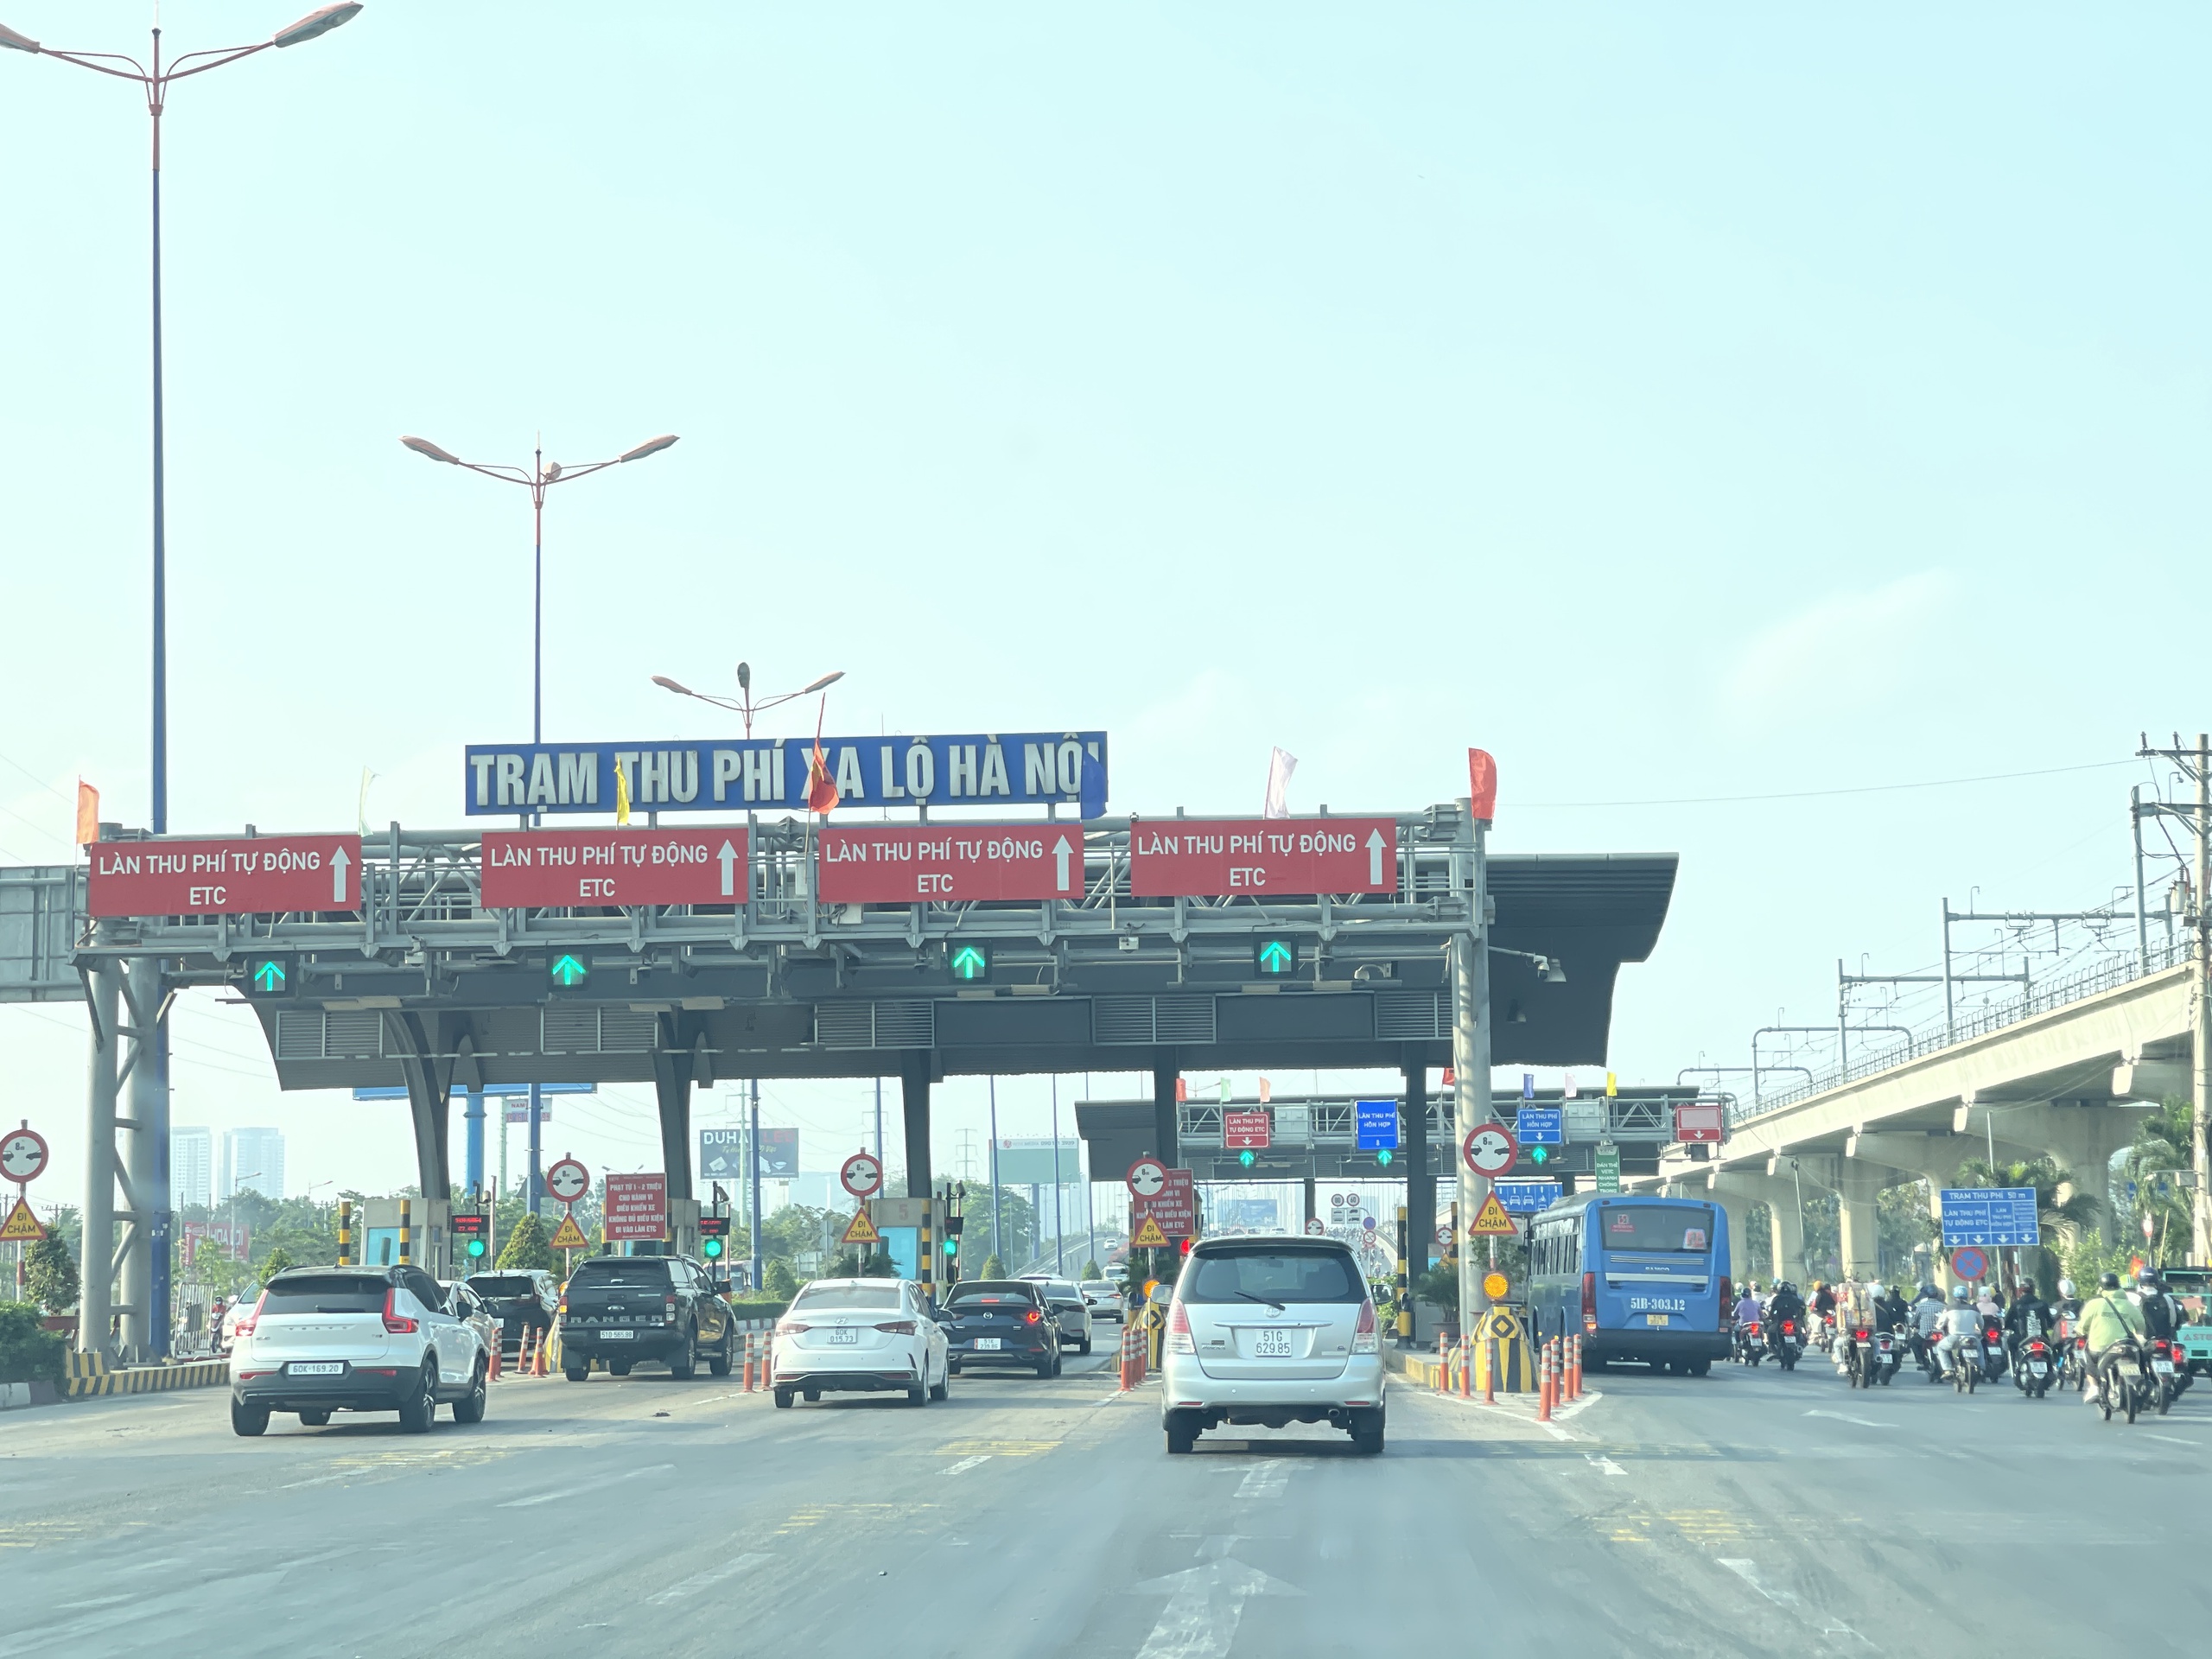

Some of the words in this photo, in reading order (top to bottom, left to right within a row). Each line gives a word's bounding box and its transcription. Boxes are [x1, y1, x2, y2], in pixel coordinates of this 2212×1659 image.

[470, 752, 598, 813] TRẠM
[615, 749, 699, 804] THU
[713, 738, 785, 802] PHÍ
[880, 735, 935, 805] LỘ
[948, 734, 1011, 797] HÀ
[1024, 732, 1099, 802] NỘ
[826, 839, 867, 862] LÀN
[872, 842, 912, 861] THU
[918, 837, 952, 861] PHÍ
[956, 839, 982, 863] TỰ
[987, 836, 1043, 862] ĐỘNG
[1137, 832, 1179, 855] LÀN
[1184, 835, 1224, 854] THU
[1230, 830, 1264, 854] PHÍ
[1268, 832, 1295, 856] TỰ
[1300, 830, 1356, 856] ĐỘNG
[491, 844, 531, 867] LÀN
[537, 847, 576, 866] THU
[582, 842, 616, 865] PHÍ
[620, 844, 647, 868] TỰ
[652, 841, 708, 867] ĐỘNG
[99, 851, 140, 875] LÀN
[146, 855, 187, 874] THU
[193, 849, 228, 873] PHÍ
[232, 851, 259, 874] TỰ
[263, 848, 321, 874] ĐỘNG
[918, 874, 953, 893] ETC
[1230, 868, 1266, 887] ETC
[580, 878, 615, 897] ETC
[189, 887, 226, 906] ETC
[17, 1212, 27, 1221] ĐI
[899, 1204, 909, 1220] 5
[1488, 1206, 1497, 1215] ĐI
[1944, 1209, 1958, 1217] LÀN
[7, 1223, 36, 1236] CHẬM
[634, 1224, 645, 1233] LÀN
[1478, 1217, 1507, 1230] CHẬM
[557, 1234, 580, 1243] CHẬM
[850, 1229, 873, 1238] CHẬM
[1139, 1233, 1162, 1243] CHẬM
[1630, 1298, 1686, 1311] 51B-303.12
[570, 1315, 663, 1324] RANGER
[1263, 1331, 1282, 1342] 51G
[1255, 1343, 1290, 1354] 629.85
